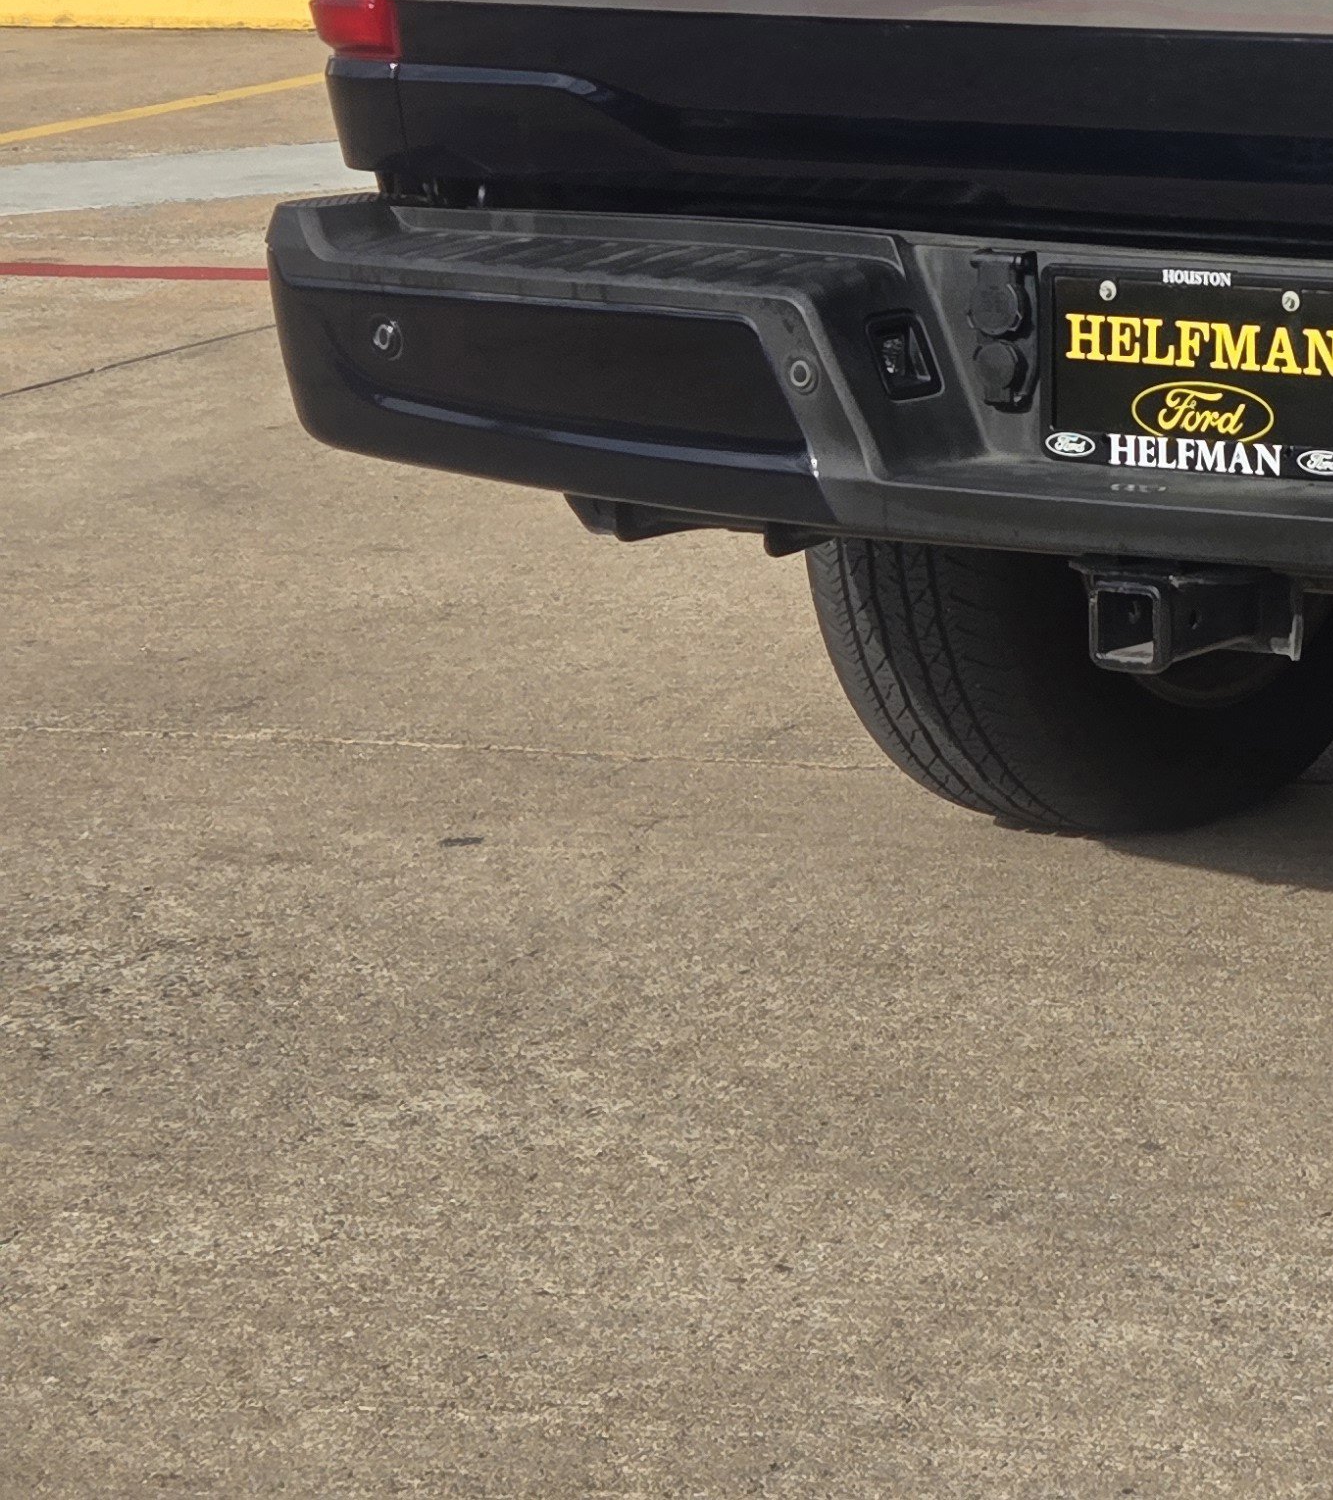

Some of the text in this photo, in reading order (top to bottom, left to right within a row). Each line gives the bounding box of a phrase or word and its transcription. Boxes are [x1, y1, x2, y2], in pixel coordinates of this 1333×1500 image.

[1162, 268, 1232, 288] HOUSTON
[1158, 387, 1247, 434] Ford
[1108, 433, 1283, 476] HELFMAN
